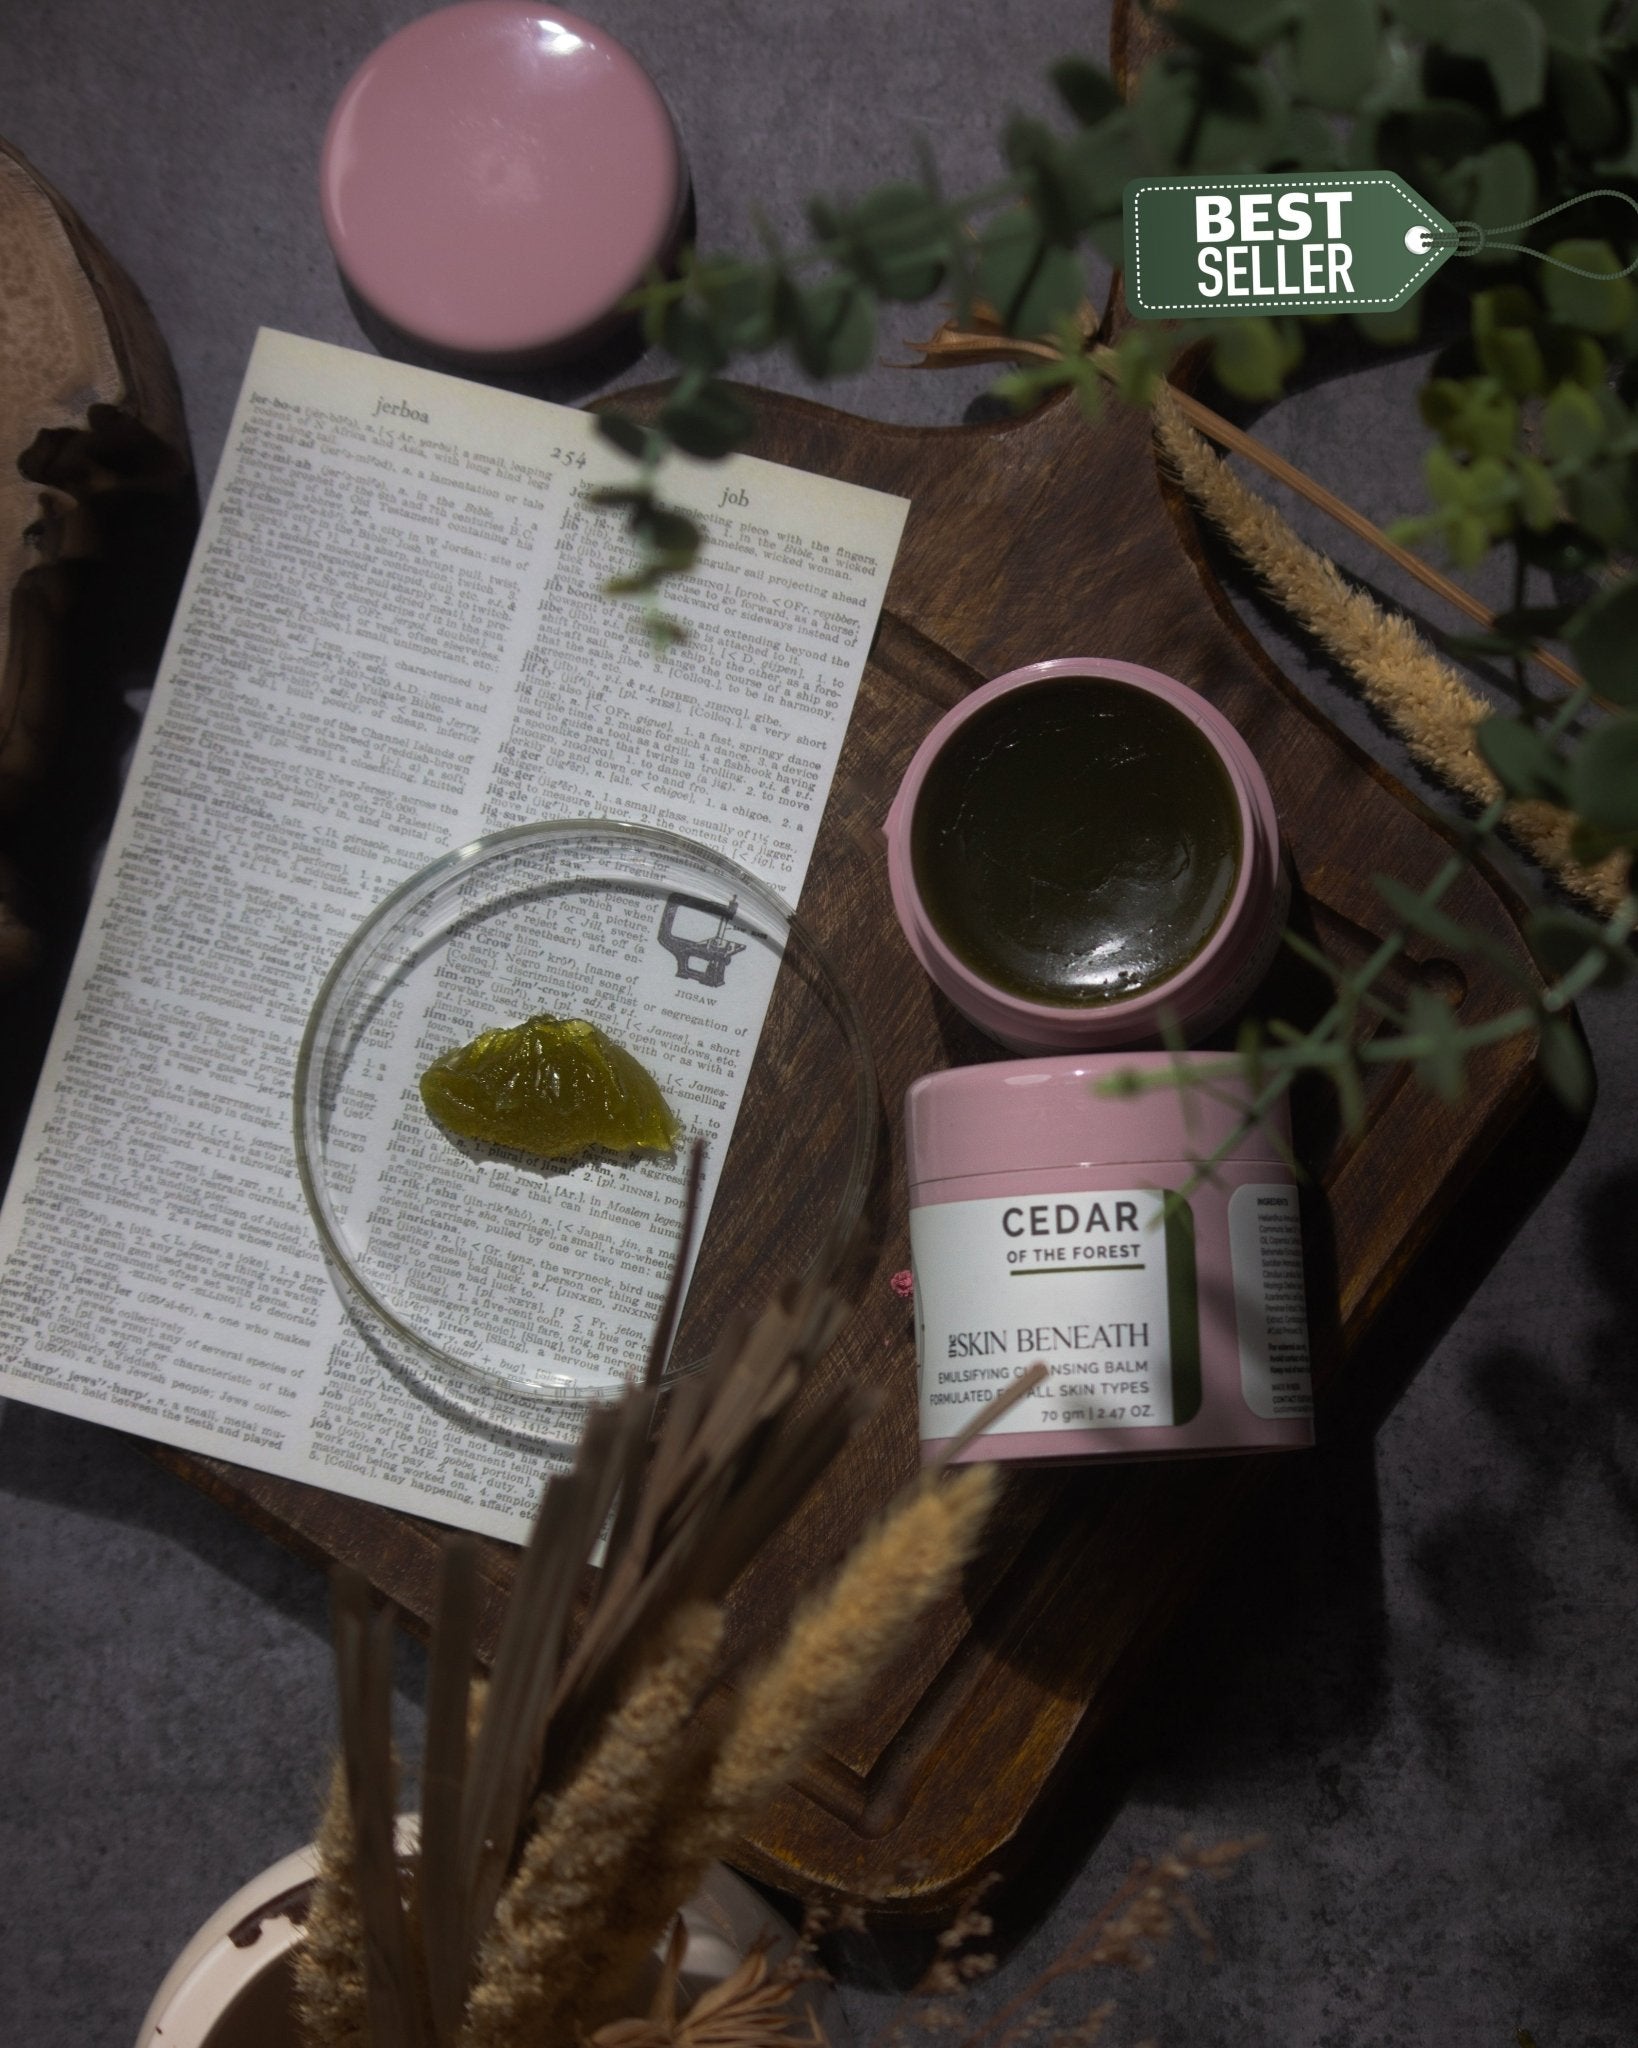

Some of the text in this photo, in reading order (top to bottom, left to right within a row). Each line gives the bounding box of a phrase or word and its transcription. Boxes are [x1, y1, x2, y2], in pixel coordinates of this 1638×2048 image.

[371, 395, 429, 424] jerboa
[550, 447, 587, 470] 254
[717, 487, 750, 509] job
[674, 989, 717, 1007] JIGSAW
[1002, 1201, 1139, 1237] CEDAR
[1006, 1244, 1141, 1264] OF THE FOREST
[957, 1330, 1007, 1358] SKIN
[1017, 1323, 1149, 1352] BENEATH
[938, 1361, 1148, 1384] EMULSIFYING CNSING BALM
[930, 1389, 993, 1406] FORMULATED
[1060, 1383, 1095, 1397] SKIN
[1101, 1381, 1150, 1395] TYPES
[1041, 1411, 1058, 1423] 70
[1062, 1410, 1085, 1424] gm
